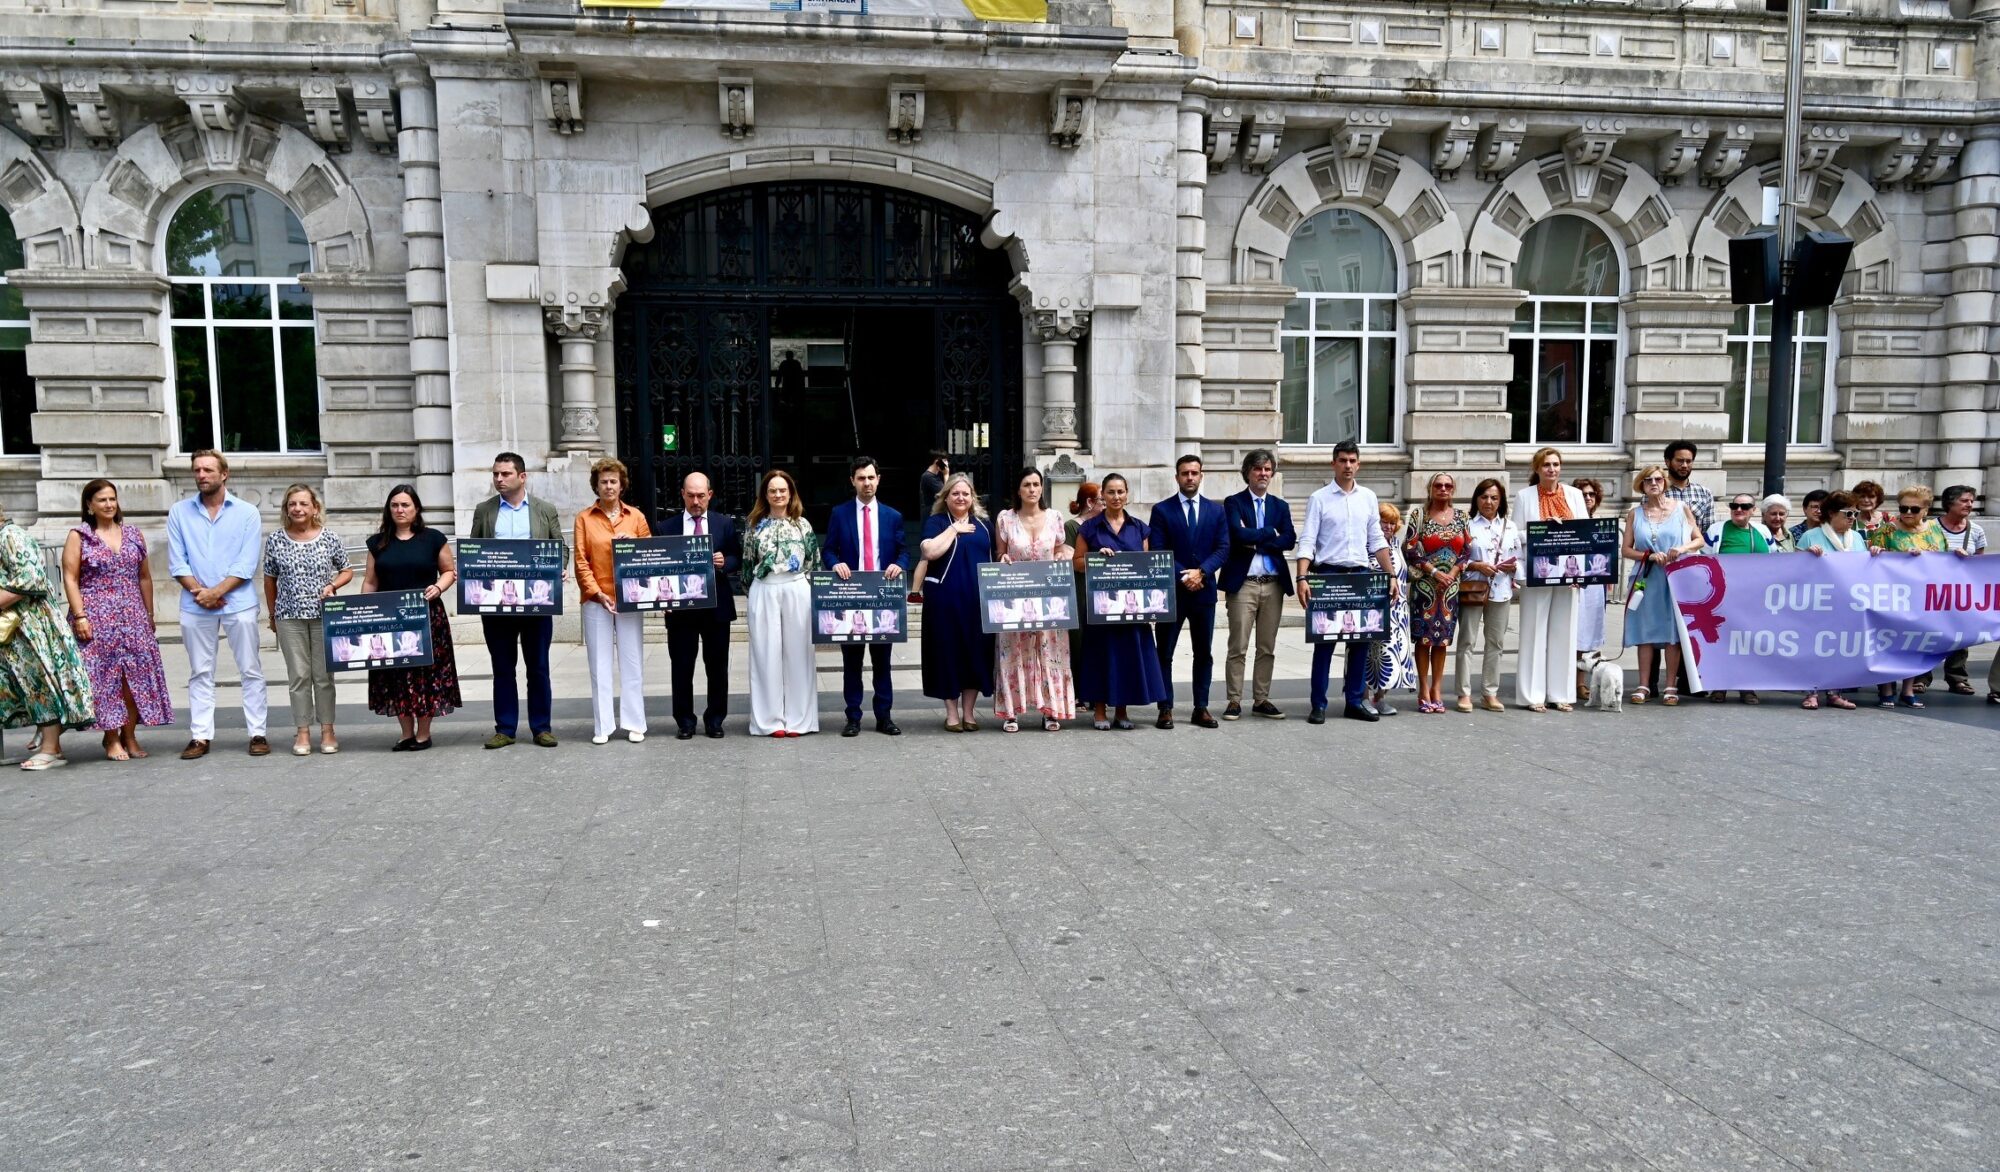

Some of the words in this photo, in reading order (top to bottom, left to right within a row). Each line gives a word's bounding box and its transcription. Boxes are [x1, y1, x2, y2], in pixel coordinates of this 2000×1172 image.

[1765, 583, 1835, 614] QUE
[1849, 583, 1912, 612] SER
[1728, 630, 1800, 657] NOS
[1814, 628, 1943, 658] CUESTE
